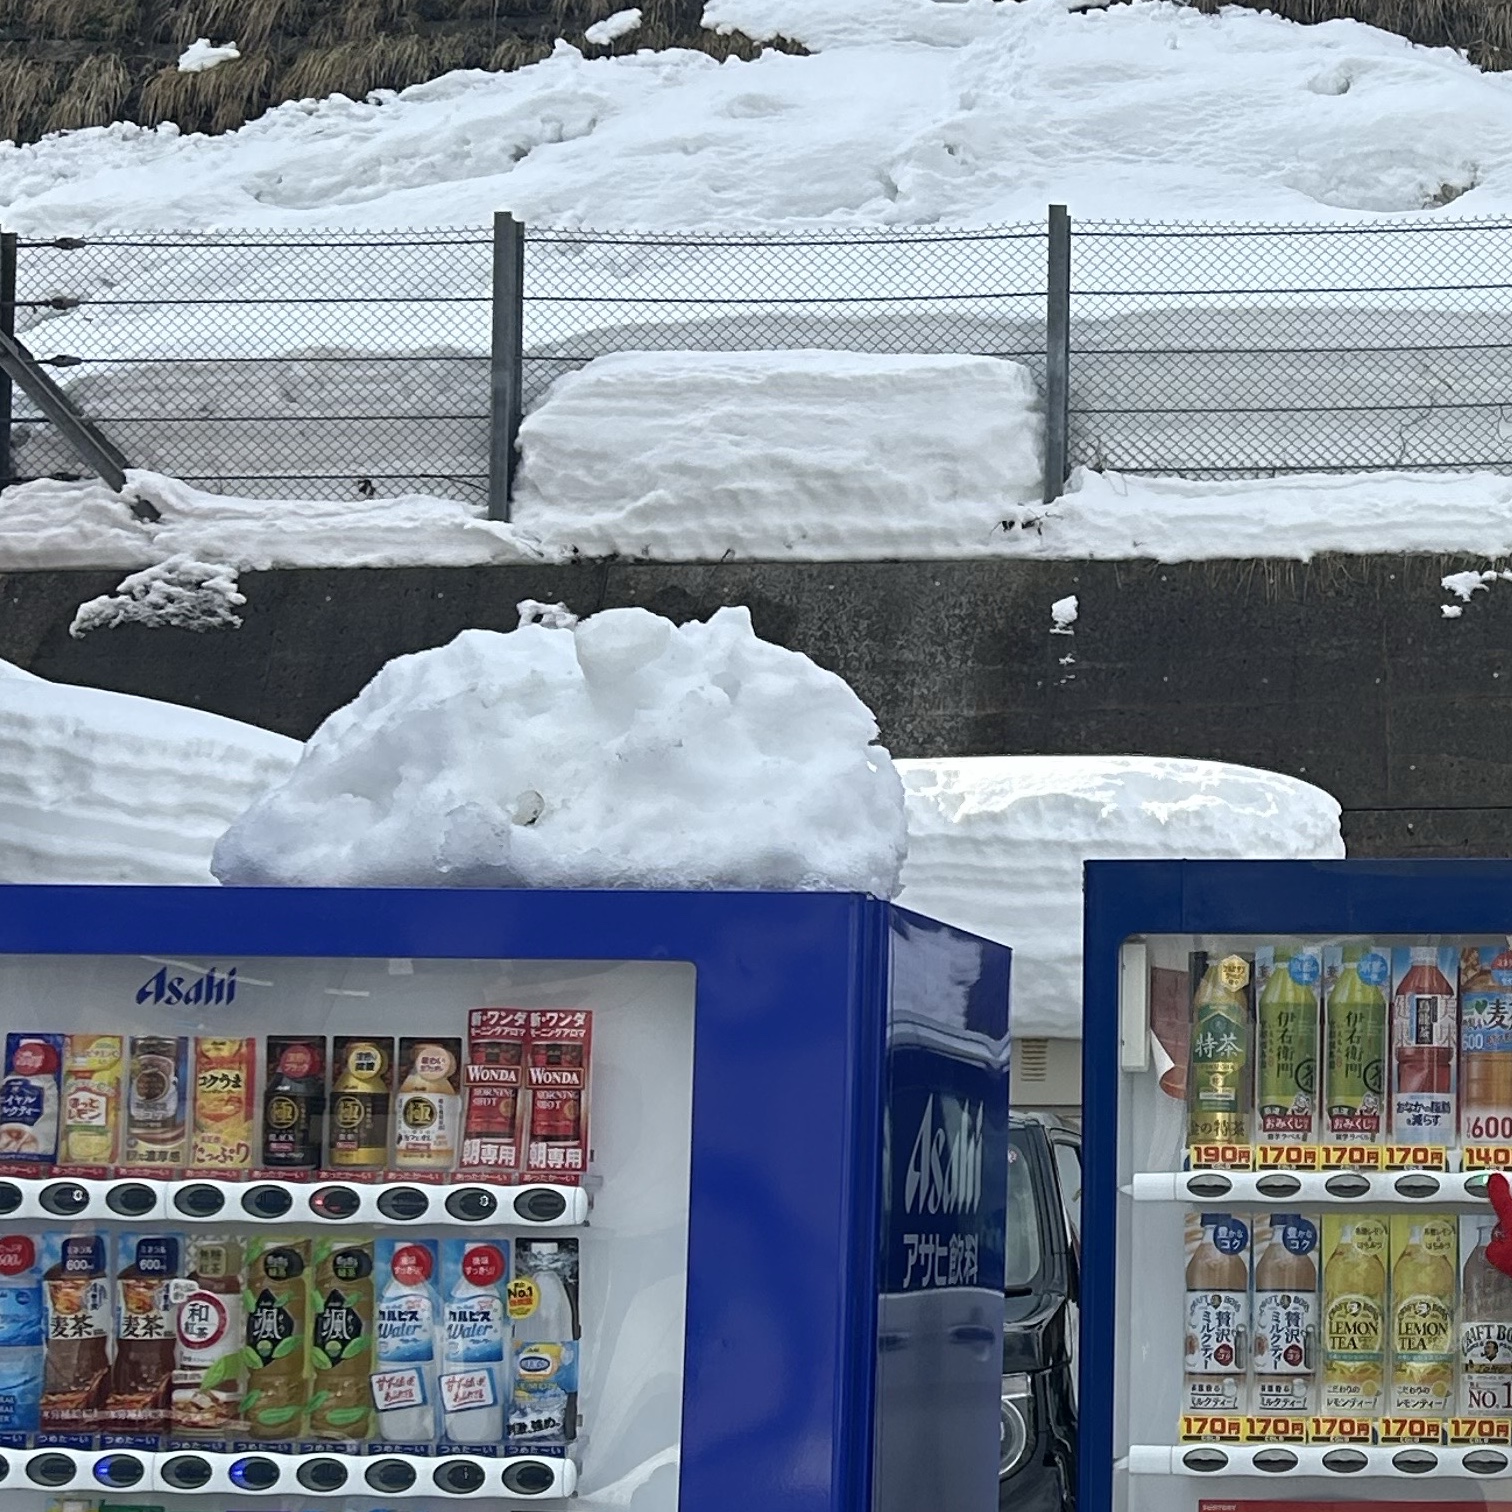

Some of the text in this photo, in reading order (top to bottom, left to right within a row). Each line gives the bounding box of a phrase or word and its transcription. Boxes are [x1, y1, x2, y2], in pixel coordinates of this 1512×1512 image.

[135, 966, 237, 1006] Asahi
[1195, 1032, 1243, 1058] 特茶
[468, 1066, 516, 1082] WONDA
[529, 1067, 579, 1084] WONDA
[463, 1139, 515, 1167] 朝専用
[530, 1140, 582, 1168] 朝専用
[904, 1092, 984, 1215] Asahi
[1194, 1147, 1250, 1163] 190円
[1260, 1147, 1316, 1163] 170円
[1322, 1147, 1379, 1163] 170円
[1386, 1147, 1443, 1165] 170円
[902, 1233, 979, 1289] アサヒ飲料
[188, 1303, 210, 1323] 和
[51, 1315, 94, 1338] 麦茶
[121, 1315, 165, 1338] 麦茶
[1328, 1322, 1379, 1336] LEMON
[1398, 1322, 1449, 1336] LEMON
[1330, 1337, 1358, 1350] TEA
[1399, 1337, 1428, 1350] TEA
[1183, 1417, 1240, 1435] 170円
[1247, 1417, 1304, 1435] 170円
[1312, 1418, 1370, 1435] 170円
[1382, 1419, 1440, 1437] 170円
[1451, 1419, 1509, 1437] 170円
